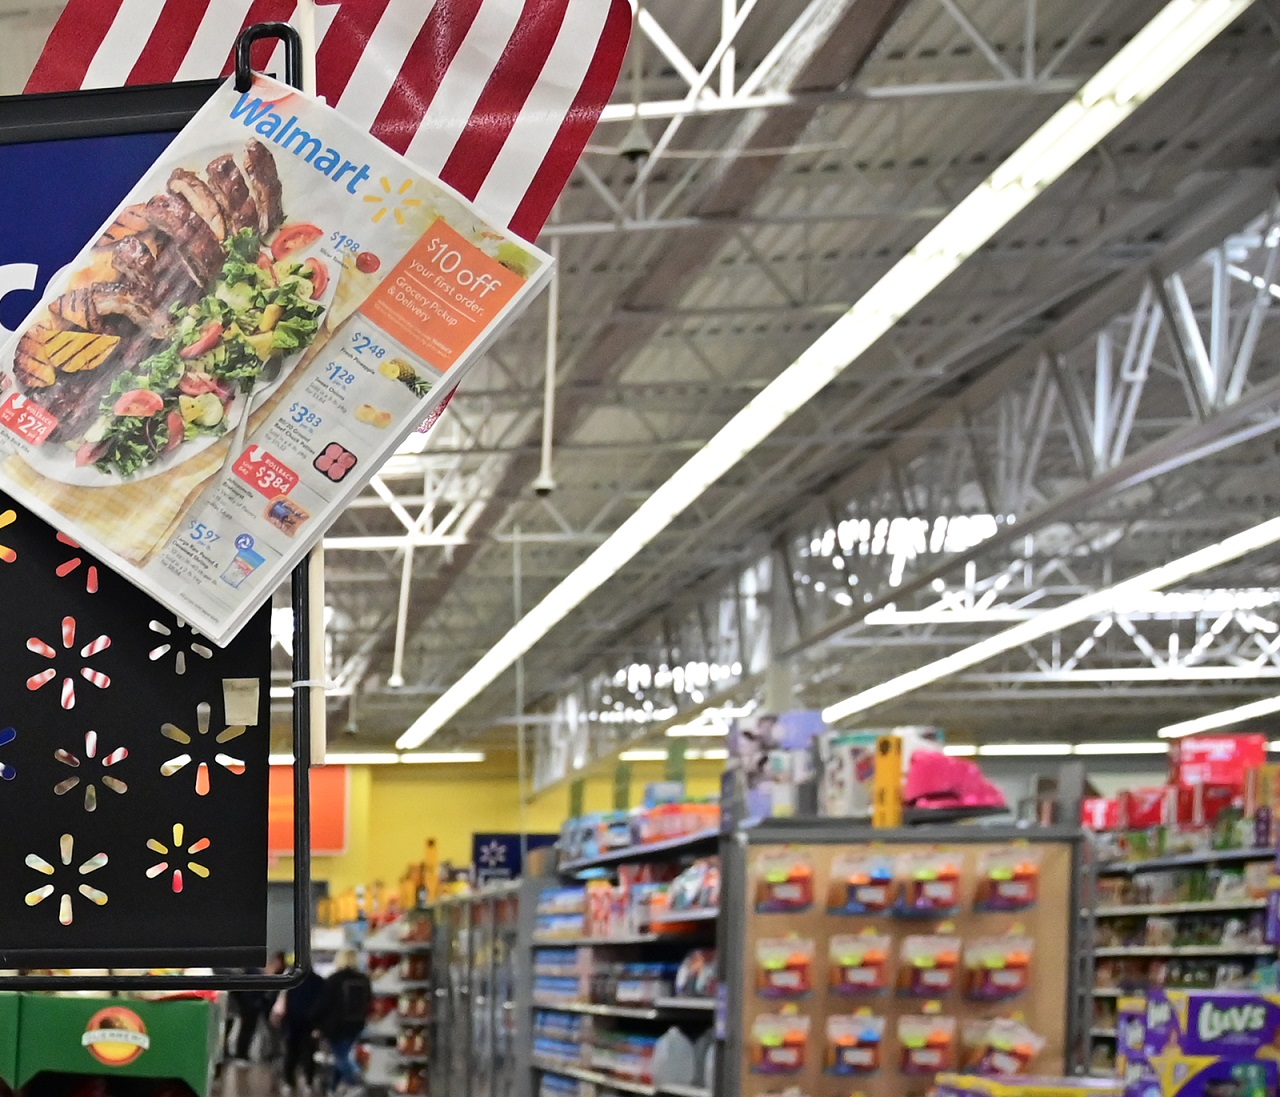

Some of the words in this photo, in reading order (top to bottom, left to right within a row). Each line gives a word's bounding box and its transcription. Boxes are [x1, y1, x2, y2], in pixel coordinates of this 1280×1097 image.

[232, 89, 370, 194] Walmart
[409, 259, 434, 280] your
[433, 275, 456, 295] first
[454, 291, 485, 315] order.
[422, 237, 463, 275] $10
[455, 261, 500, 301] off
[393, 276, 431, 307] Grocery
[428, 301, 459, 327] Pickup
[394, 291, 432, 322] Delivery
[264, 459, 294, 481] ROLLBACK
[1197, 998, 1268, 1042] Luvs
